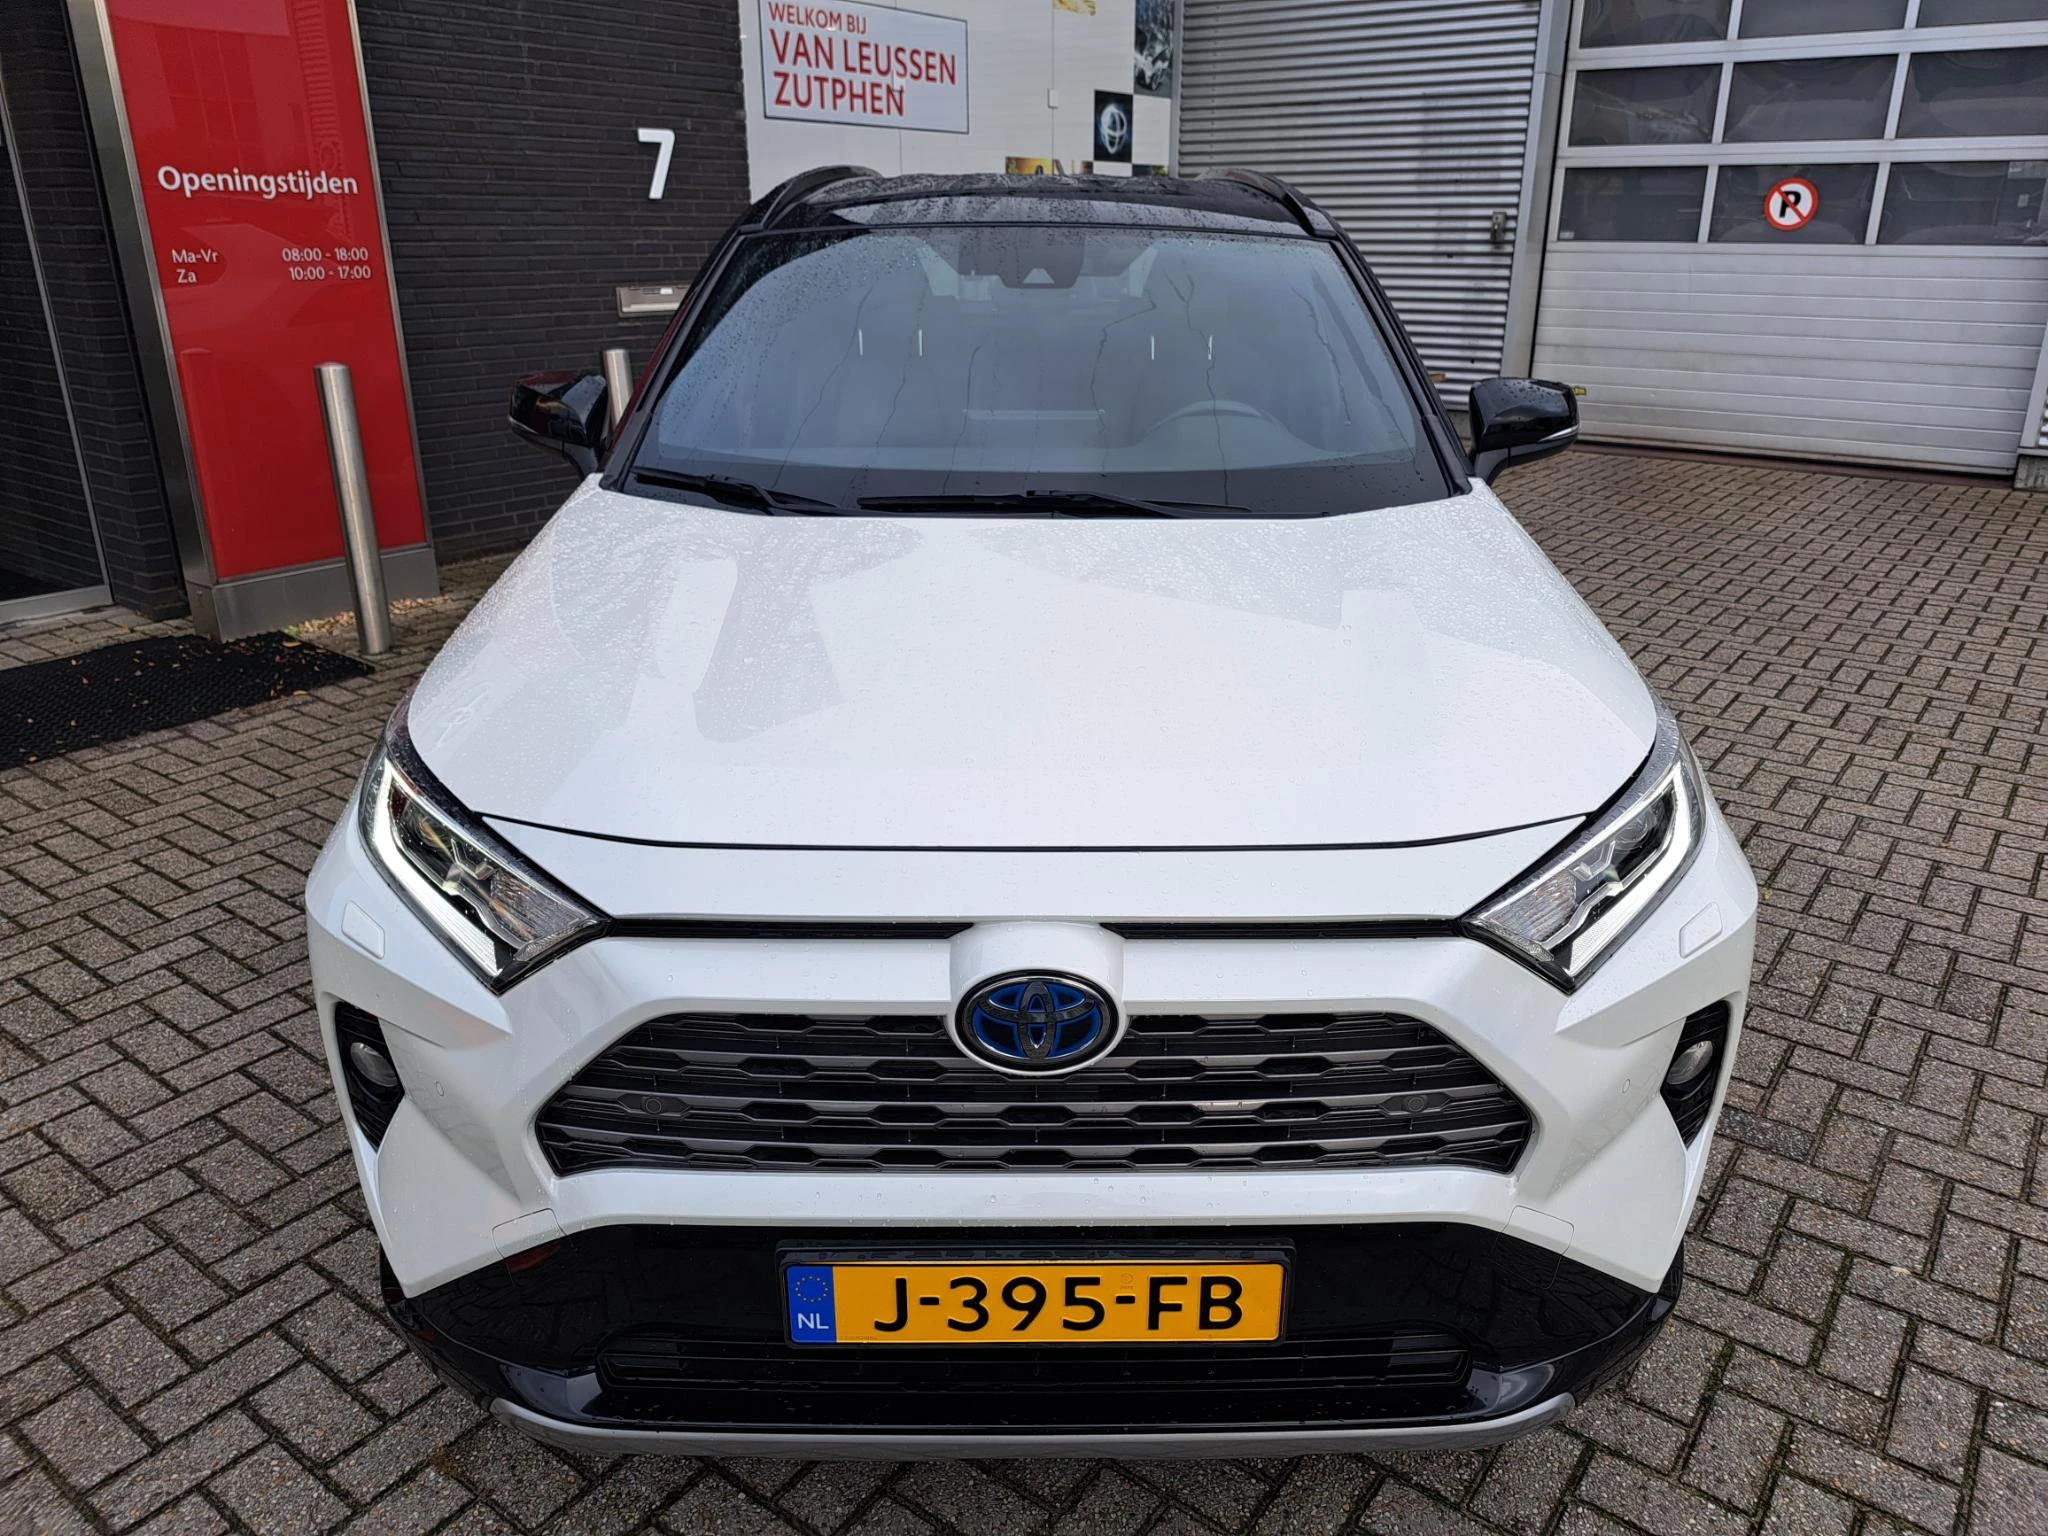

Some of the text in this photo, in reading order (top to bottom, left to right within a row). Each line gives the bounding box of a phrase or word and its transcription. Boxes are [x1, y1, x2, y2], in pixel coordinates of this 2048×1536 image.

[768, 2, 867, 34] WELKOM BIJ
[769, 28, 956, 86] VAN LEUSSEN
[773, 71, 904, 117] ZUTPHEN
[637, 127, 676, 200] 7
[157, 165, 358, 199] Openingstijden
[171, 248, 219, 264] Ma-Vr
[282, 247, 322, 262] 08:00
[334, 247, 369, 261] 18:00
[176, 268, 197, 284] Za
[289, 266, 325, 280] 10:00
[337, 265, 371, 279] 17:00
[797, 1312, 829, 1329] NL
[873, 1275, 1243, 1332] J-395-FB
